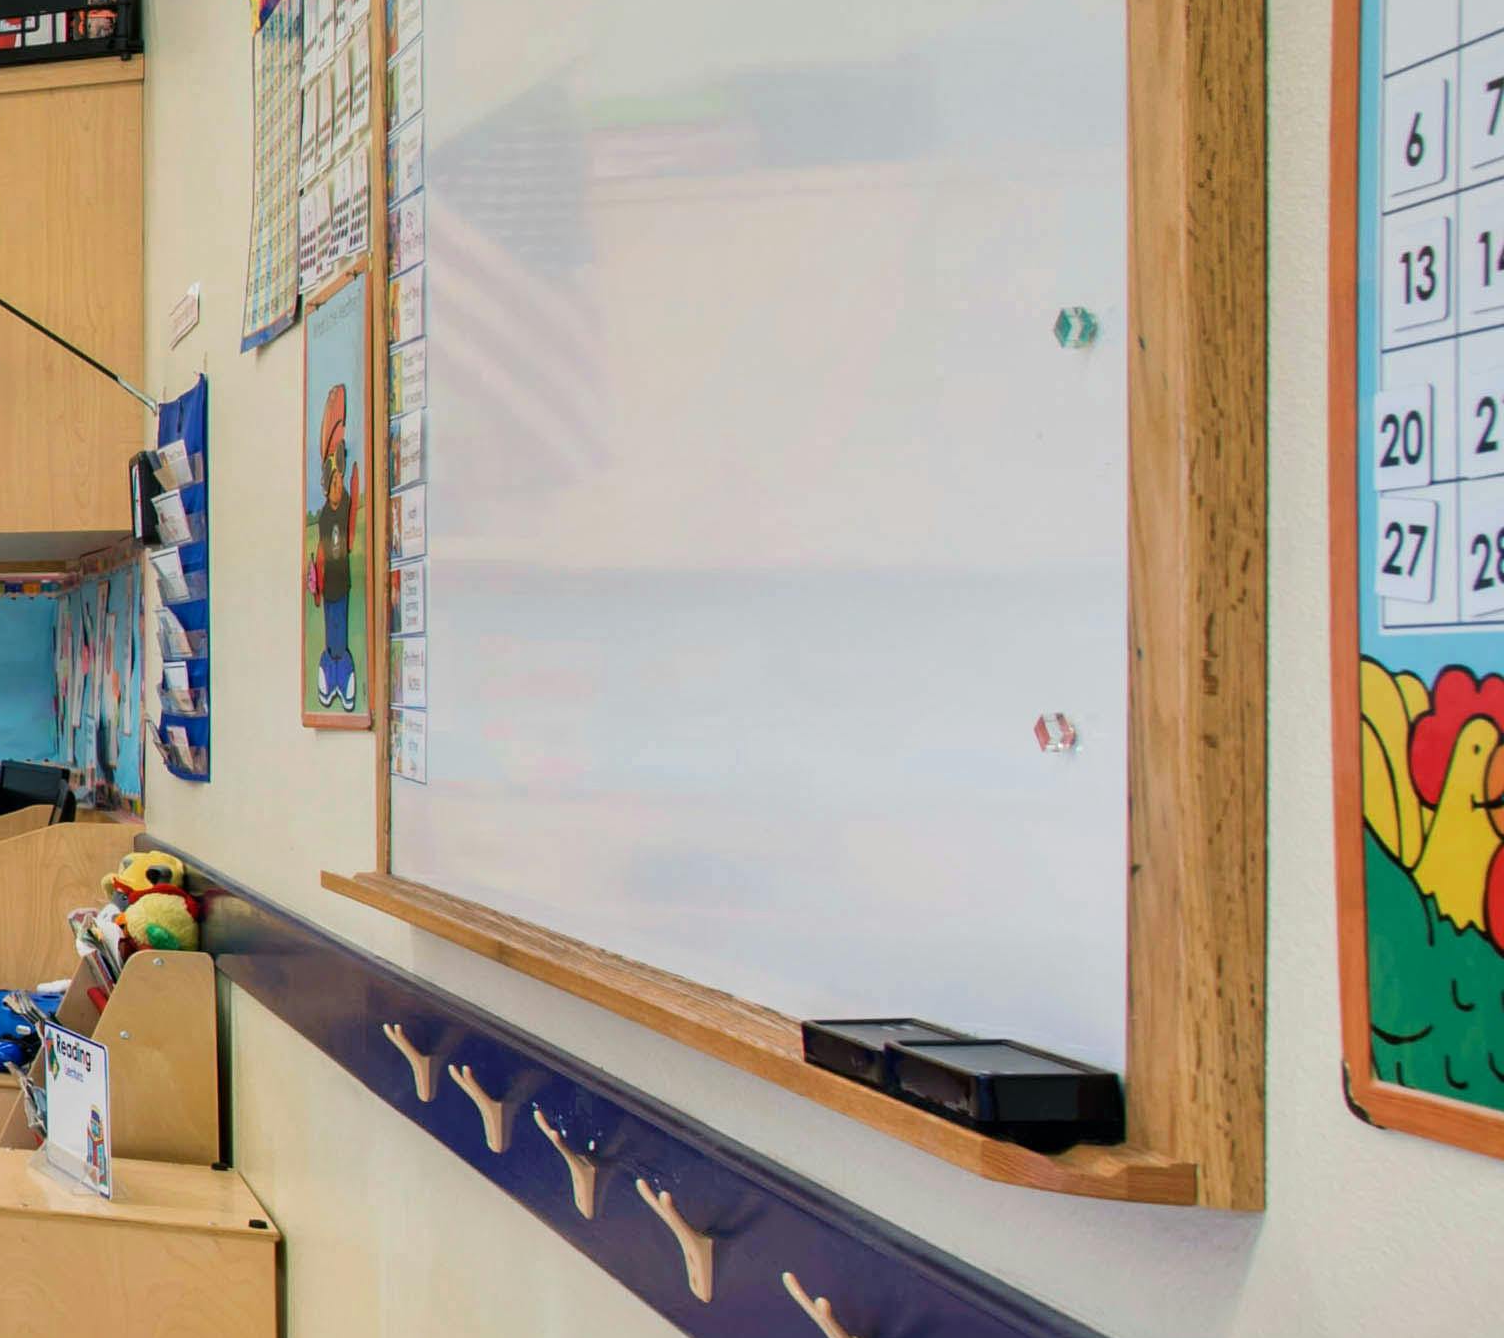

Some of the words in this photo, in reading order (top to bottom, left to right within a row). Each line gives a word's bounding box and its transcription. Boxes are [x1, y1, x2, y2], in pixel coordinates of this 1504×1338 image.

[1406, 112, 1424, 167] 6
[1399, 246, 1437, 305] 13
[1381, 410, 1425, 467] 20
[1382, 523, 1428, 577] 27
[56, 1033, 91, 1072] Reading
